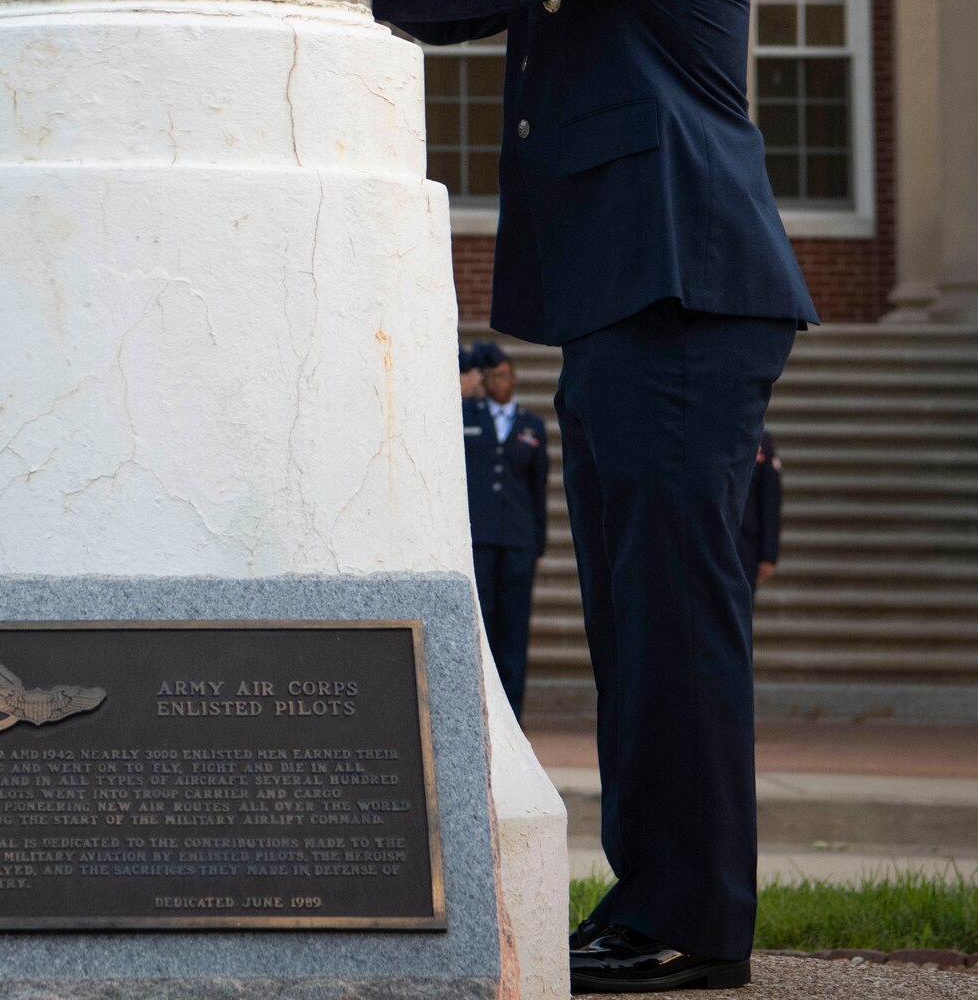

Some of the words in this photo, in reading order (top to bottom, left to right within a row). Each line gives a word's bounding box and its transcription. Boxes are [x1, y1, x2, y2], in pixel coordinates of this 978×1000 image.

[157, 680, 225, 695] ARMY
[236, 680, 276, 695] AIR
[288, 680, 358, 695] CORPS
[157, 700, 262, 716] ENLISTED
[274, 700, 356, 716] PILOTS
[10, 750, 39, 760] AND
[43, 750, 74, 760] 1942
[80, 750, 139, 760] NEARLY
[145, 750, 177, 760] 3000
[183, 750, 252, 760] ENLISTED
[257, 750, 287, 760] MEN
[293, 750, 350, 760] EARNED
[356, 750, 398, 760] THEIR
[11, 763, 41, 773] AND
[48, 763, 92, 773] WENT
[98, 763, 116, 773] ON
[125, 763, 143, 773] TO
[193, 763, 236, 773] FIGHT
[244, 763, 273, 773] AND
[281, 763, 304, 773] DIE
[312, 763, 326, 773] IN
[334, 763, 364, 773] ALL
[1, 776, 30, 786] AND
[36, 776, 50, 786] IN
[59, 776, 89, 786] ALL
[96, 776, 143, 785] TYPES
[150, 776, 170, 785] OF
[255, 776, 322, 785] SEVERAL
[330, 776, 398, 785] HUNDRED
[42, 790, 85, 800] WENT
[93, 790, 127, 800] INTO
[134, 790, 178, 799] TROOP
[185, 789, 249, 799] CARRIER
[257, 789, 286, 799] AND
[294, 789, 341, 799] CARGO
[4, 802, 90, 812] PIONEERING
[98, 802, 130, 812] NEW
[139, 802, 164, 811] AIR
[174, 802, 230, 811] ROUTES
[238, 802, 268, 811] ALL
[275, 802, 314, 811] OVER
[322, 802, 350, 811] THE
[358, 802, 410, 811] WORLD
[21, 816, 48, 825] THE
[54, 816, 98, 825] START
[106, 816, 123, 825] OF
[131, 816, 158, 825] THE
[165, 815, 235, 825] MILITARY
[244, 815, 304, 825] AIRLIFT
[24, 839, 37, 849] IS
[42, 839, 119, 849] DEDICATED
[126, 839, 144, 848] TO
[150, 838, 178, 848] THE
[184, 838, 298, 848] CONTRIBUTIONS
[304, 838, 344, 848] MADE
[350, 838, 369, 848] TO
[374, 838, 405, 848] THE
[4, 852, 74, 862] MILITARY
[80, 852, 146, 862] AVIATION
[153, 852, 172, 862] BY
[178, 852, 249, 862] ENLISTED
[313, 852, 340, 862] THE
[346, 852, 406, 862] HEROISM
[44, 866, 73, 876] AND
[79, 866, 109, 876] THE
[114, 866, 195, 876] SACRIFICES
[198, 865, 239, 876] THEY
[247, 865, 287, 876] MADE
[315, 865, 377, 876] DEFENSE
[382, 865, 399, 876] OF
[155, 897, 234, 908] DEDICATED
[242, 897, 283, 908] JUNE
[291, 897, 322, 908] 1989
